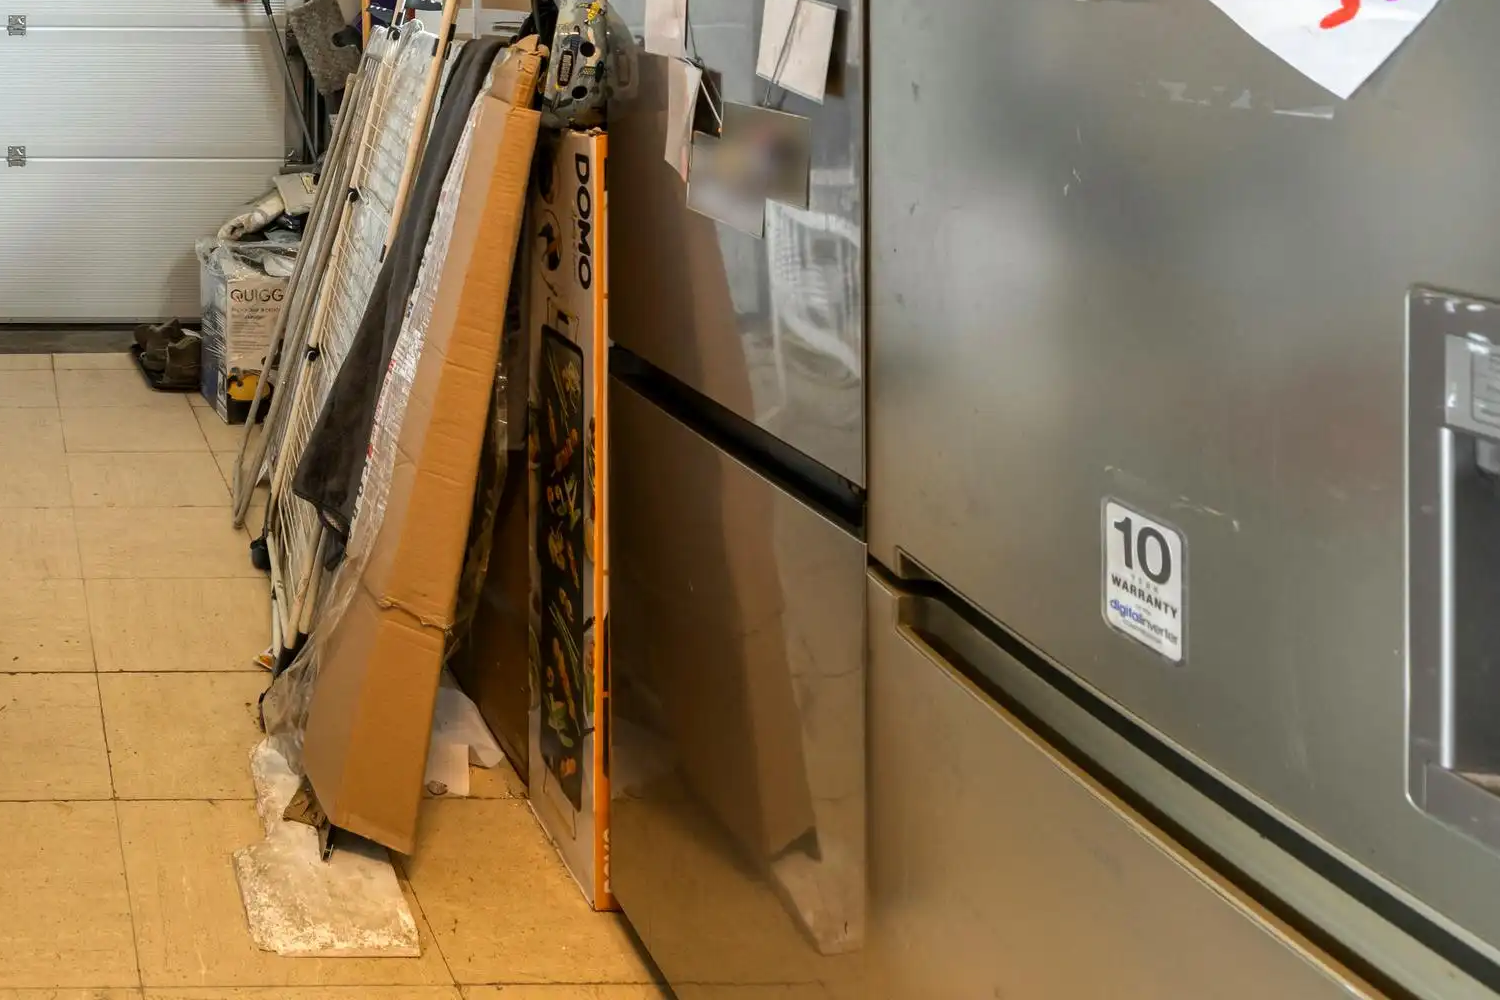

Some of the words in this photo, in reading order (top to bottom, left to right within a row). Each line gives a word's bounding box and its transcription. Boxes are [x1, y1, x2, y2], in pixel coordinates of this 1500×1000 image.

[573, 152, 592, 291] DOMO
[230, 288, 285, 303] QUIGG
[1113, 516, 1172, 586] 10
[1110, 572, 1179, 619] WARRANTY
